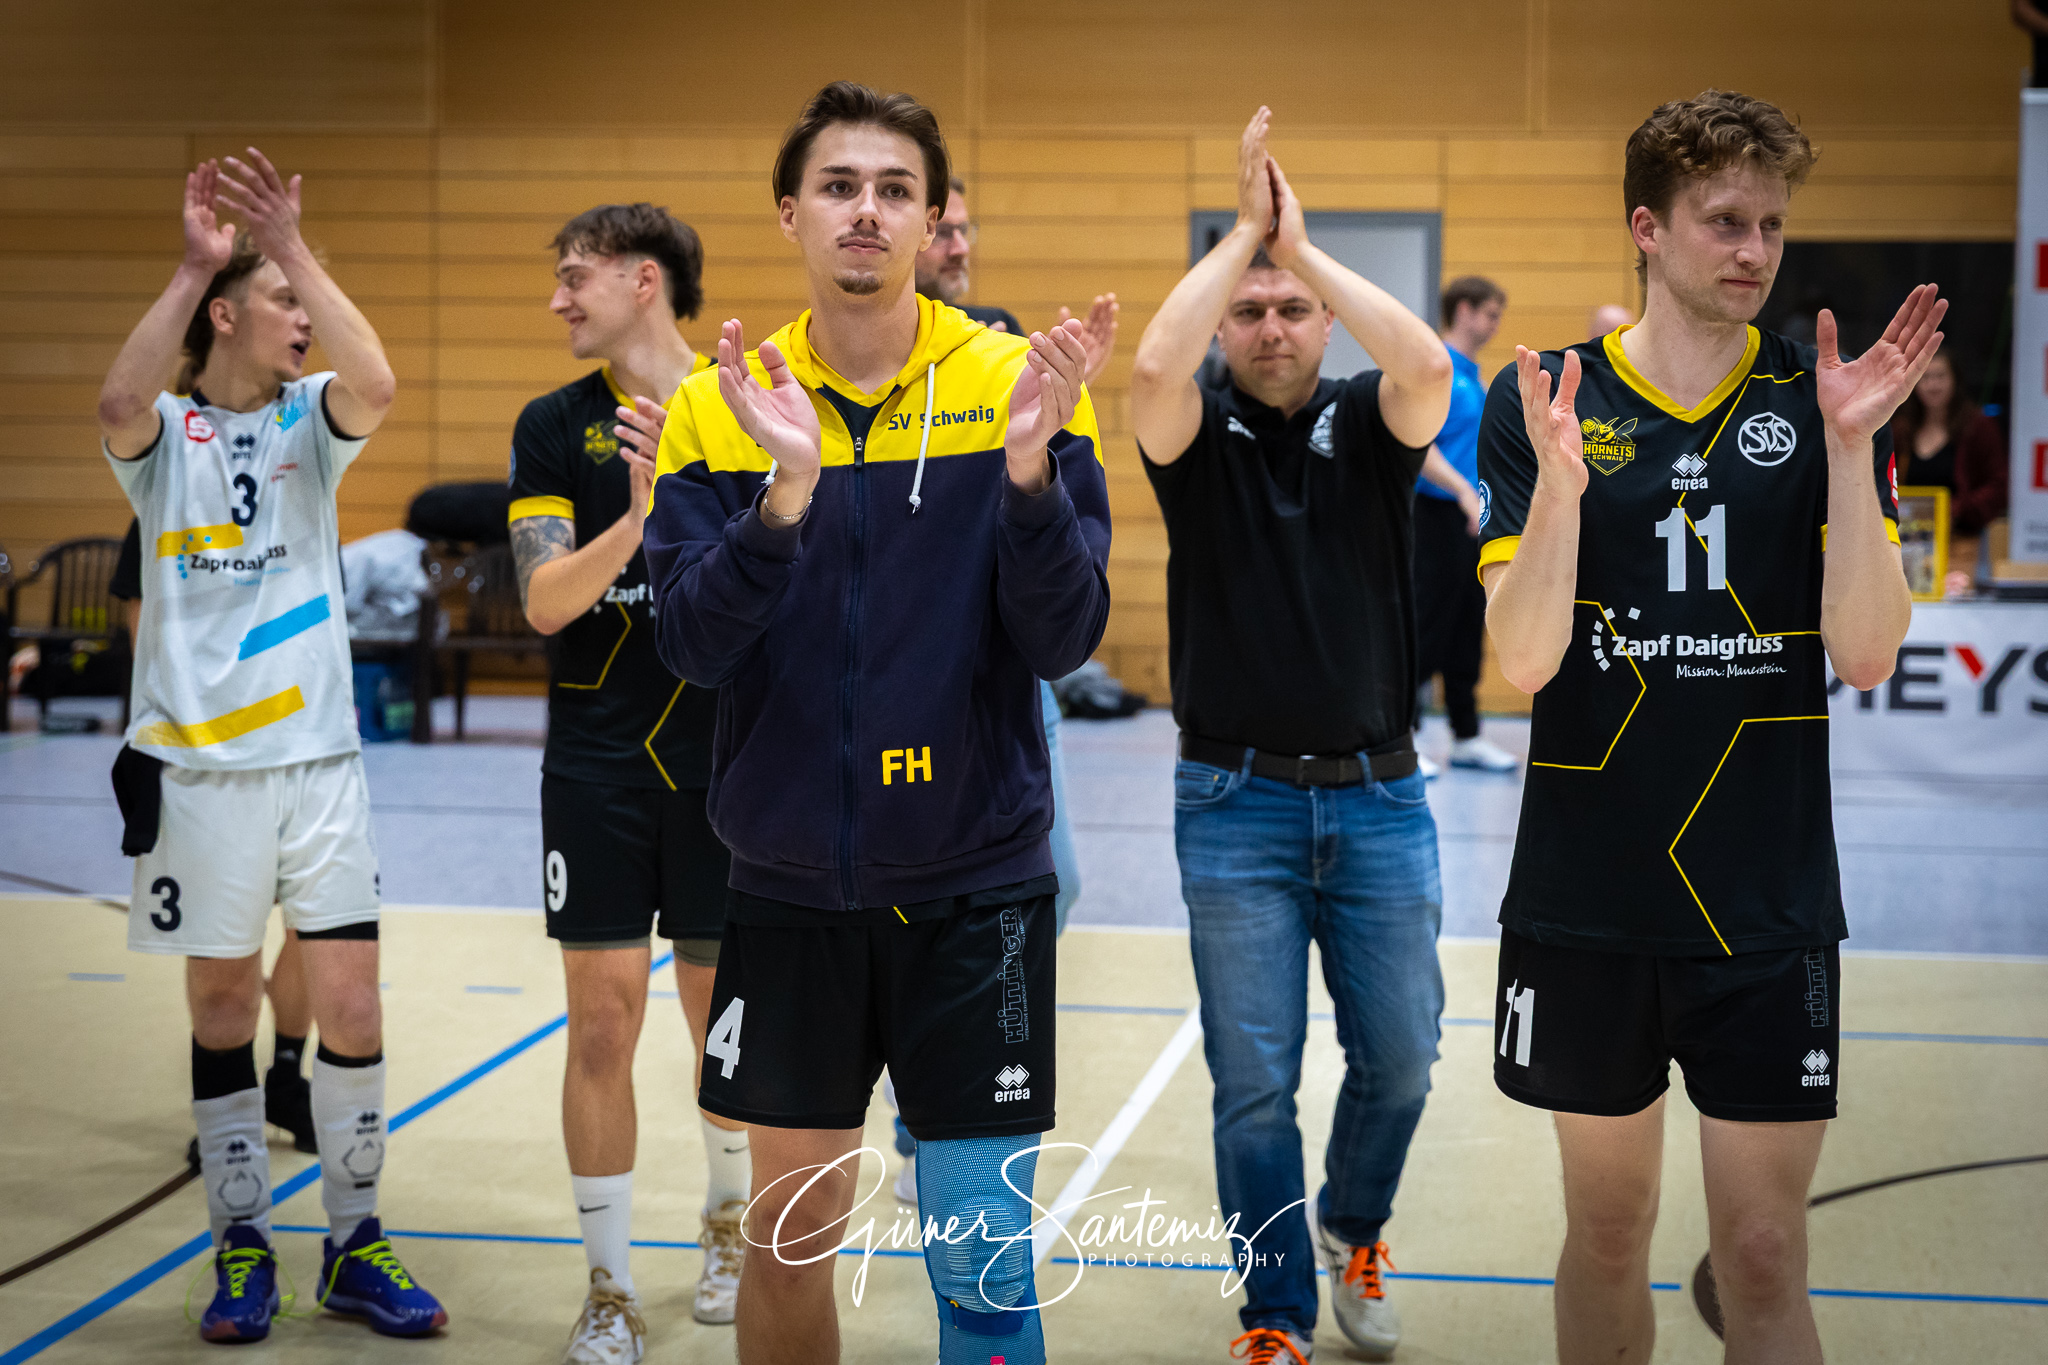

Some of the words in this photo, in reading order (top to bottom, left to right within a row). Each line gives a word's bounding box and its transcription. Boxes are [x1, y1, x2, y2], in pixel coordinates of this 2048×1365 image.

[888, 413, 911, 430] SV
[1584, 444, 1633, 458] HORNETS
[1592, 454, 1624, 462] SCHWAIG
[1671, 476, 1709, 491] errea
[232, 473, 258, 527] 3
[1655, 504, 1726, 592] 11
[604, 583, 646, 606] Zapf
[1611, 635, 1671, 662] Zapf
[1676, 633, 1783, 661] Daigfuss
[1676, 664, 1726, 679] Mission:
[1726, 663, 1788, 679] Mauerstein
[881, 746, 933, 786] FH
[546, 849, 569, 912] 9
[149, 876, 182, 932] 3
[706, 997, 745, 1080] 4
[1801, 1073, 1830, 1087] errea
[994, 1087, 1030, 1103] errea
